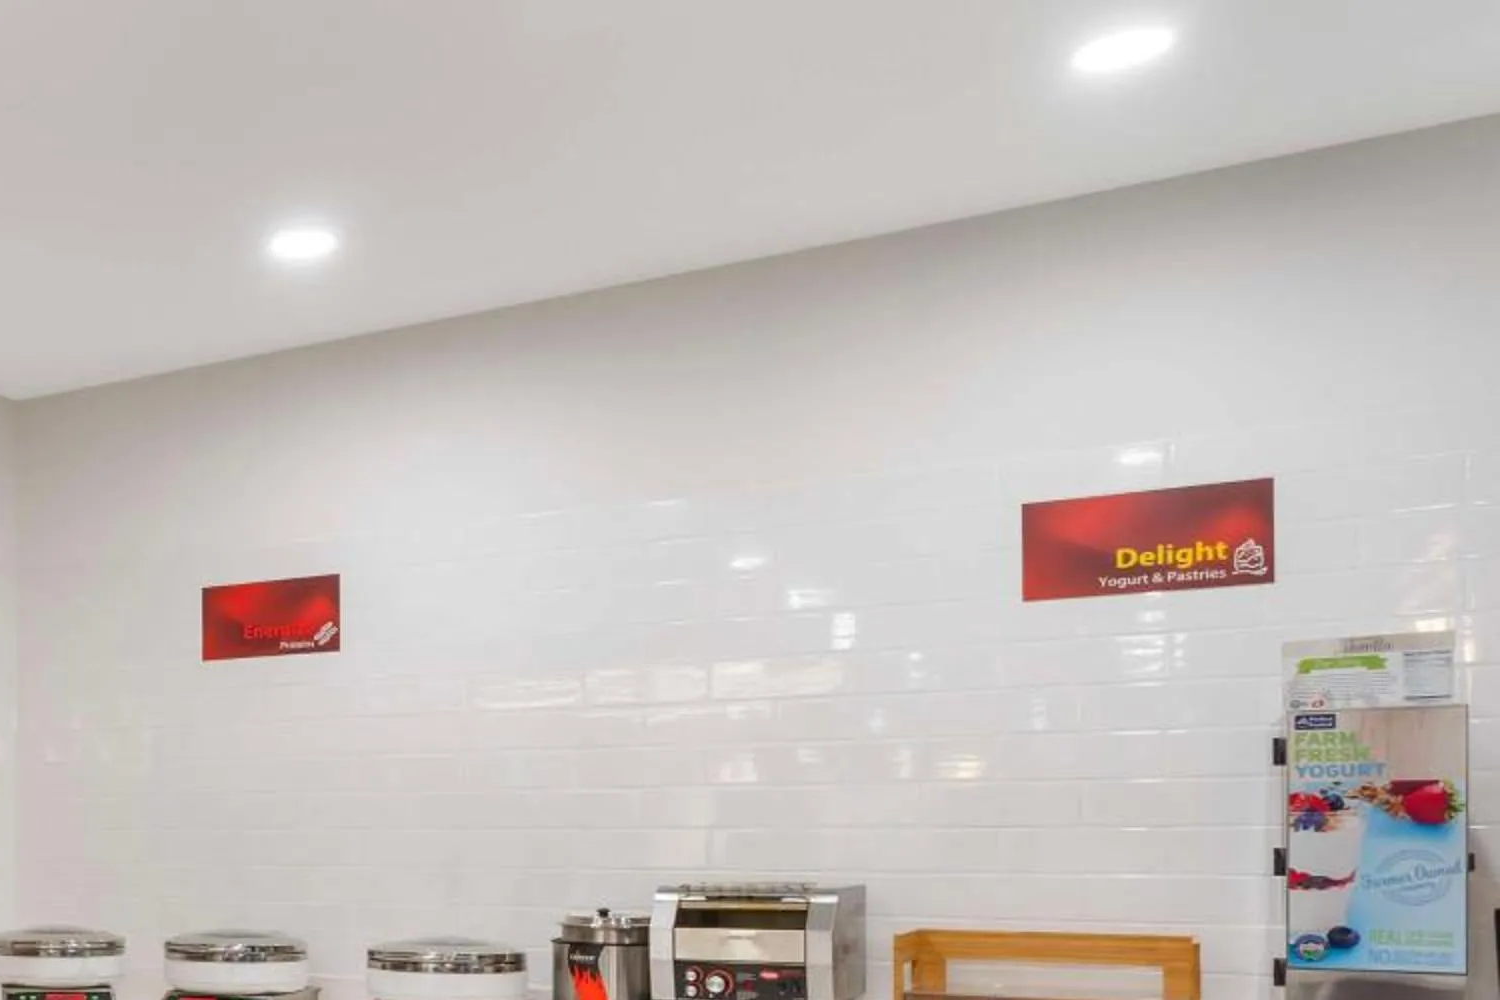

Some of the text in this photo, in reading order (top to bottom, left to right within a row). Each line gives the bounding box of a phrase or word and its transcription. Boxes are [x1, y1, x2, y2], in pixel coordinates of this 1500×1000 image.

[1115, 541, 1229, 569] Delight
[1098, 569, 1227, 589] Yogurt & Pastries
[1294, 731, 1355, 746] FARM
[1294, 746, 1371, 762] FRESH
[1295, 762, 1387, 778] YOGURT
